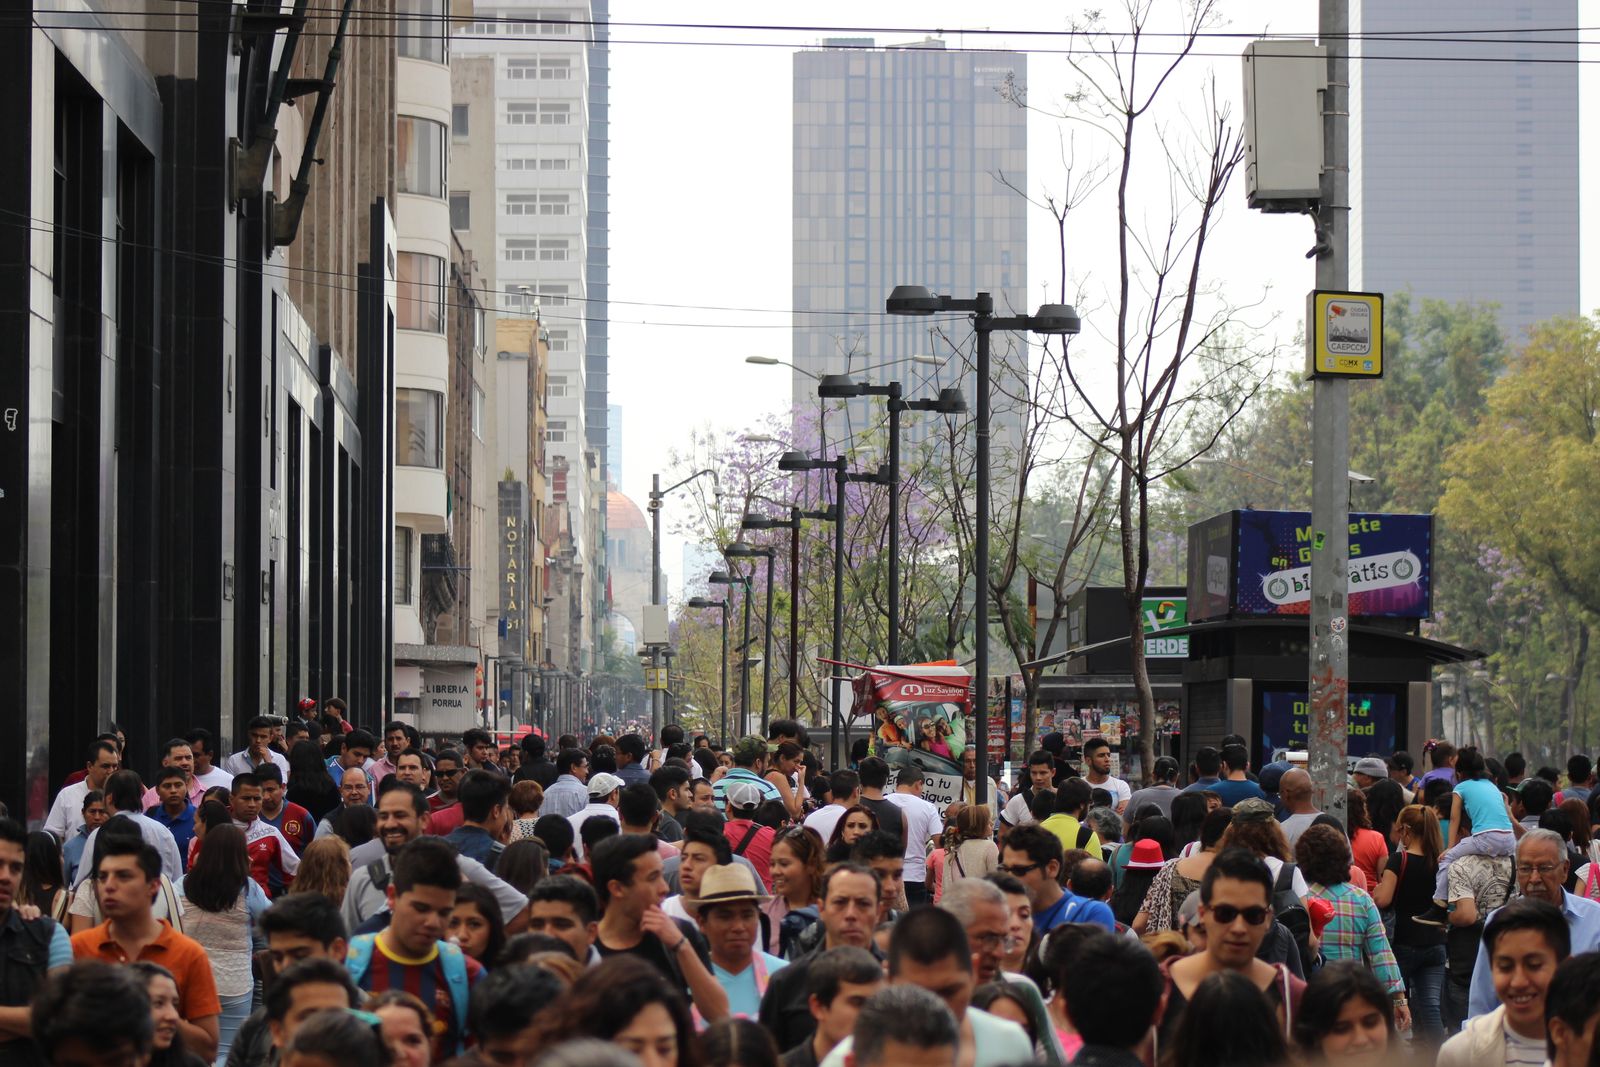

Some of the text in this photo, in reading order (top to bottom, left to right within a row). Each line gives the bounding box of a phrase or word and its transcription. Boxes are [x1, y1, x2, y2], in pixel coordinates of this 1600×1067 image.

[1331, 342, 1366, 351] CAEPCCM
[1339, 359, 1358, 367] CDMX
[506, 516, 517, 611] NOTARIA
[1271, 556, 1287, 567] en
[1144, 639, 1188, 654] ERDE
[426, 684, 469, 694] LIBRERIA
[432, 698, 462, 708] PORRUA
[938, 778, 951, 789] tu
[920, 790, 952, 804] sigue
